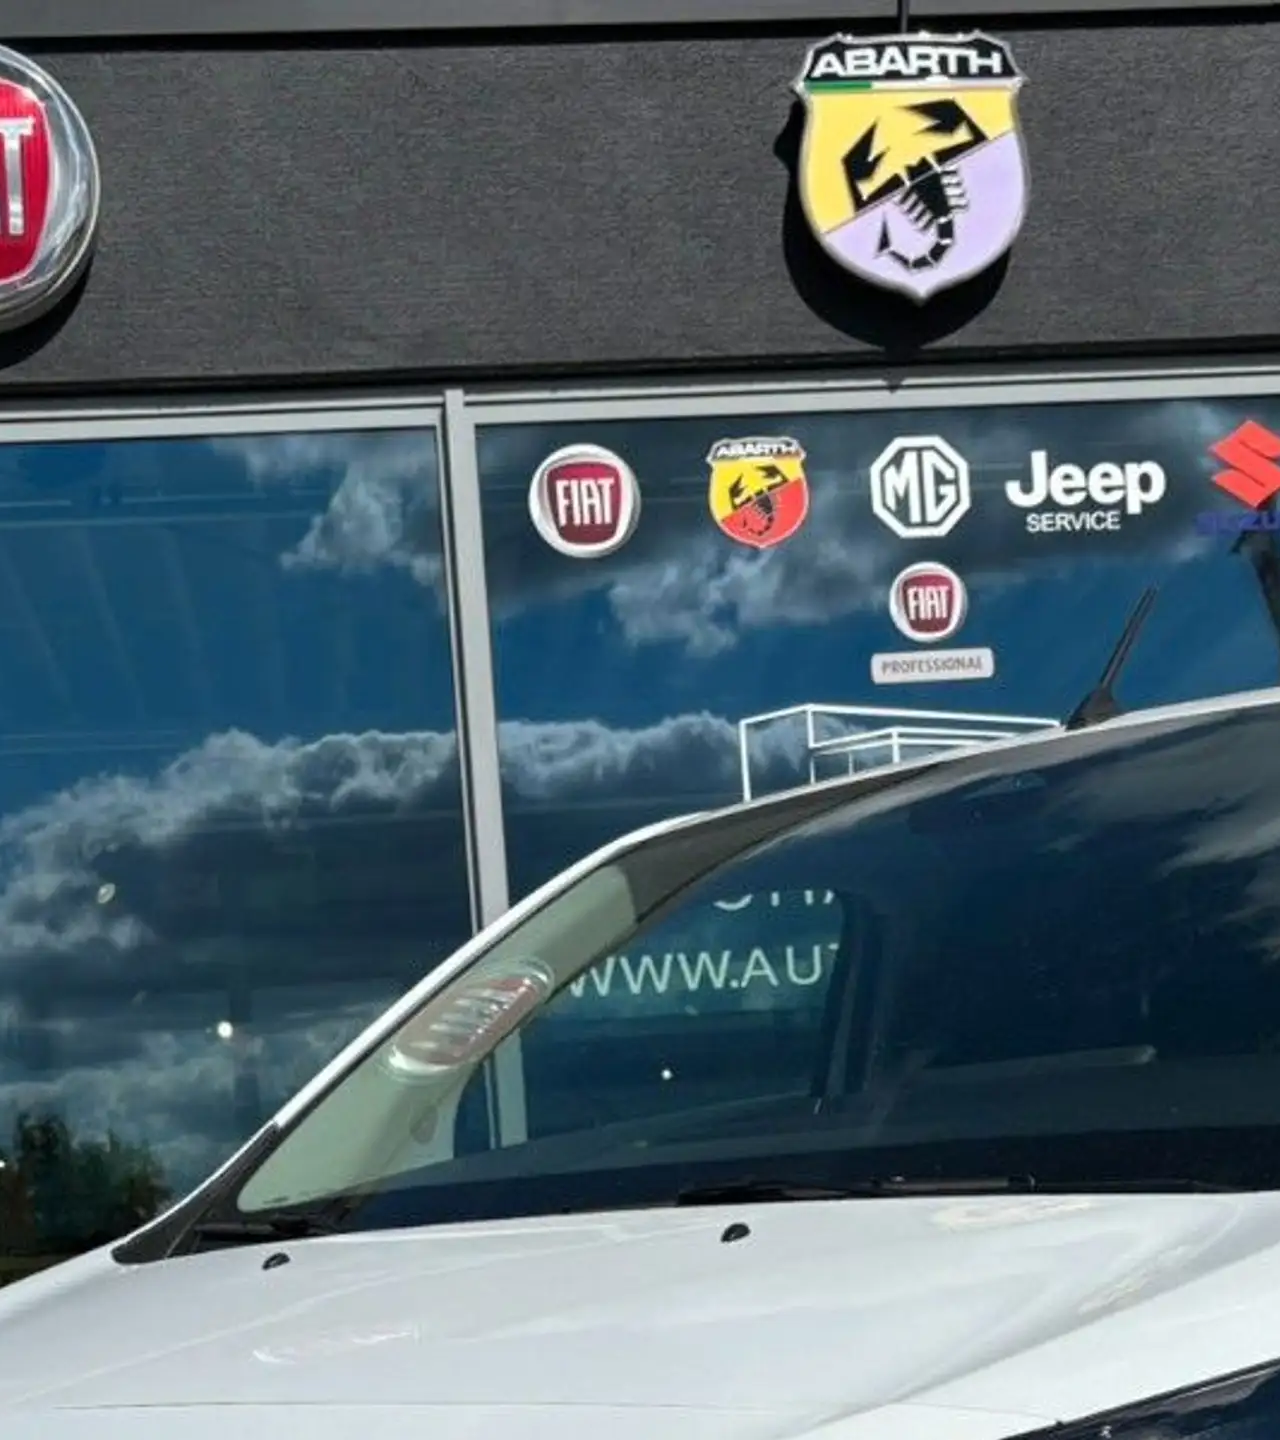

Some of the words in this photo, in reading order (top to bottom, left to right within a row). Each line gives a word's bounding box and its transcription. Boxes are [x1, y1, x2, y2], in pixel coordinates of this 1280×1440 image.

[811, 46, 1003, 77] ABARTH
[555, 477, 614, 526] FIAT
[882, 449, 957, 524] MG
[1005, 450, 1166, 515] Jeep
[1026, 511, 1121, 532] SERVICE
[907, 585, 949, 621] FIAT
[880, 655, 983, 676] PROFESSIONAL
[570, 942, 839, 998] WWW.AU
